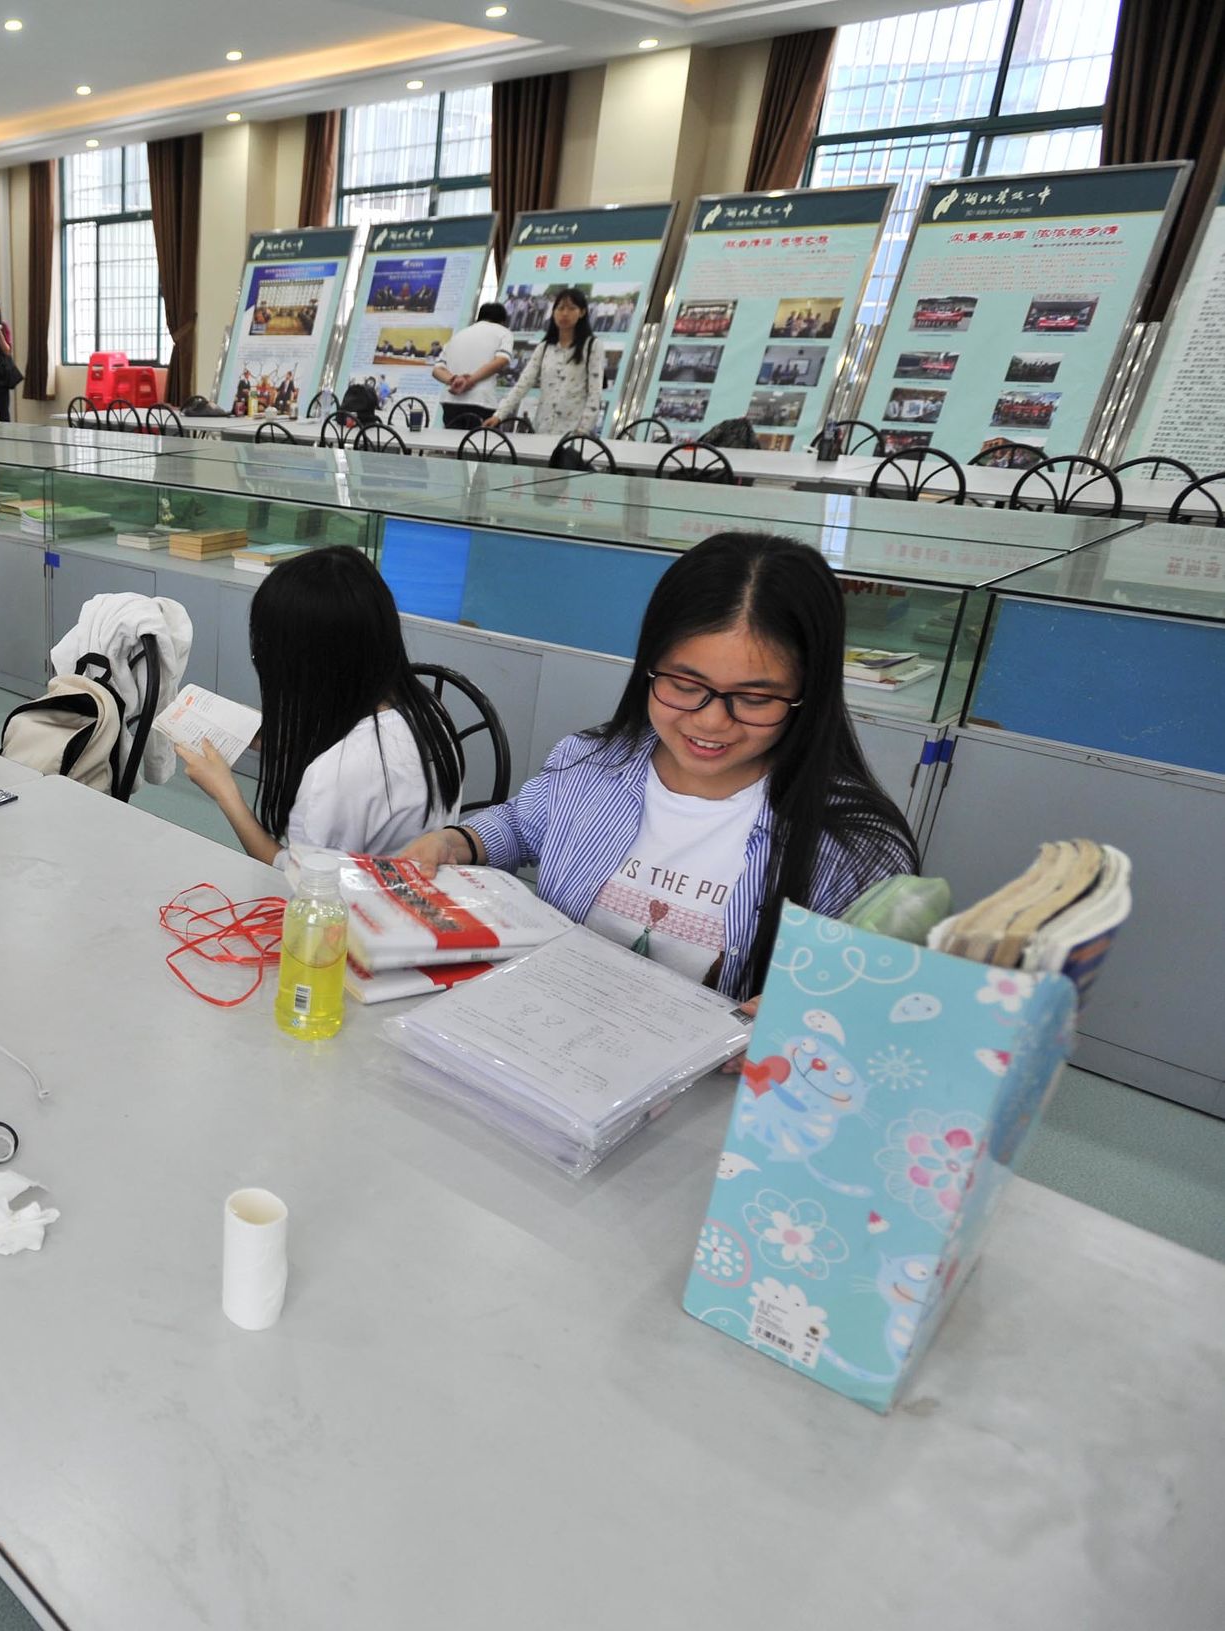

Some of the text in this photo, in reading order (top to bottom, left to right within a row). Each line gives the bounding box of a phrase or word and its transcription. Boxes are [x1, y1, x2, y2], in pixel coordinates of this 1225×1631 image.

[534, 251, 627, 270] 领导关怀
[620, 857, 728, 905] IS THE PO
